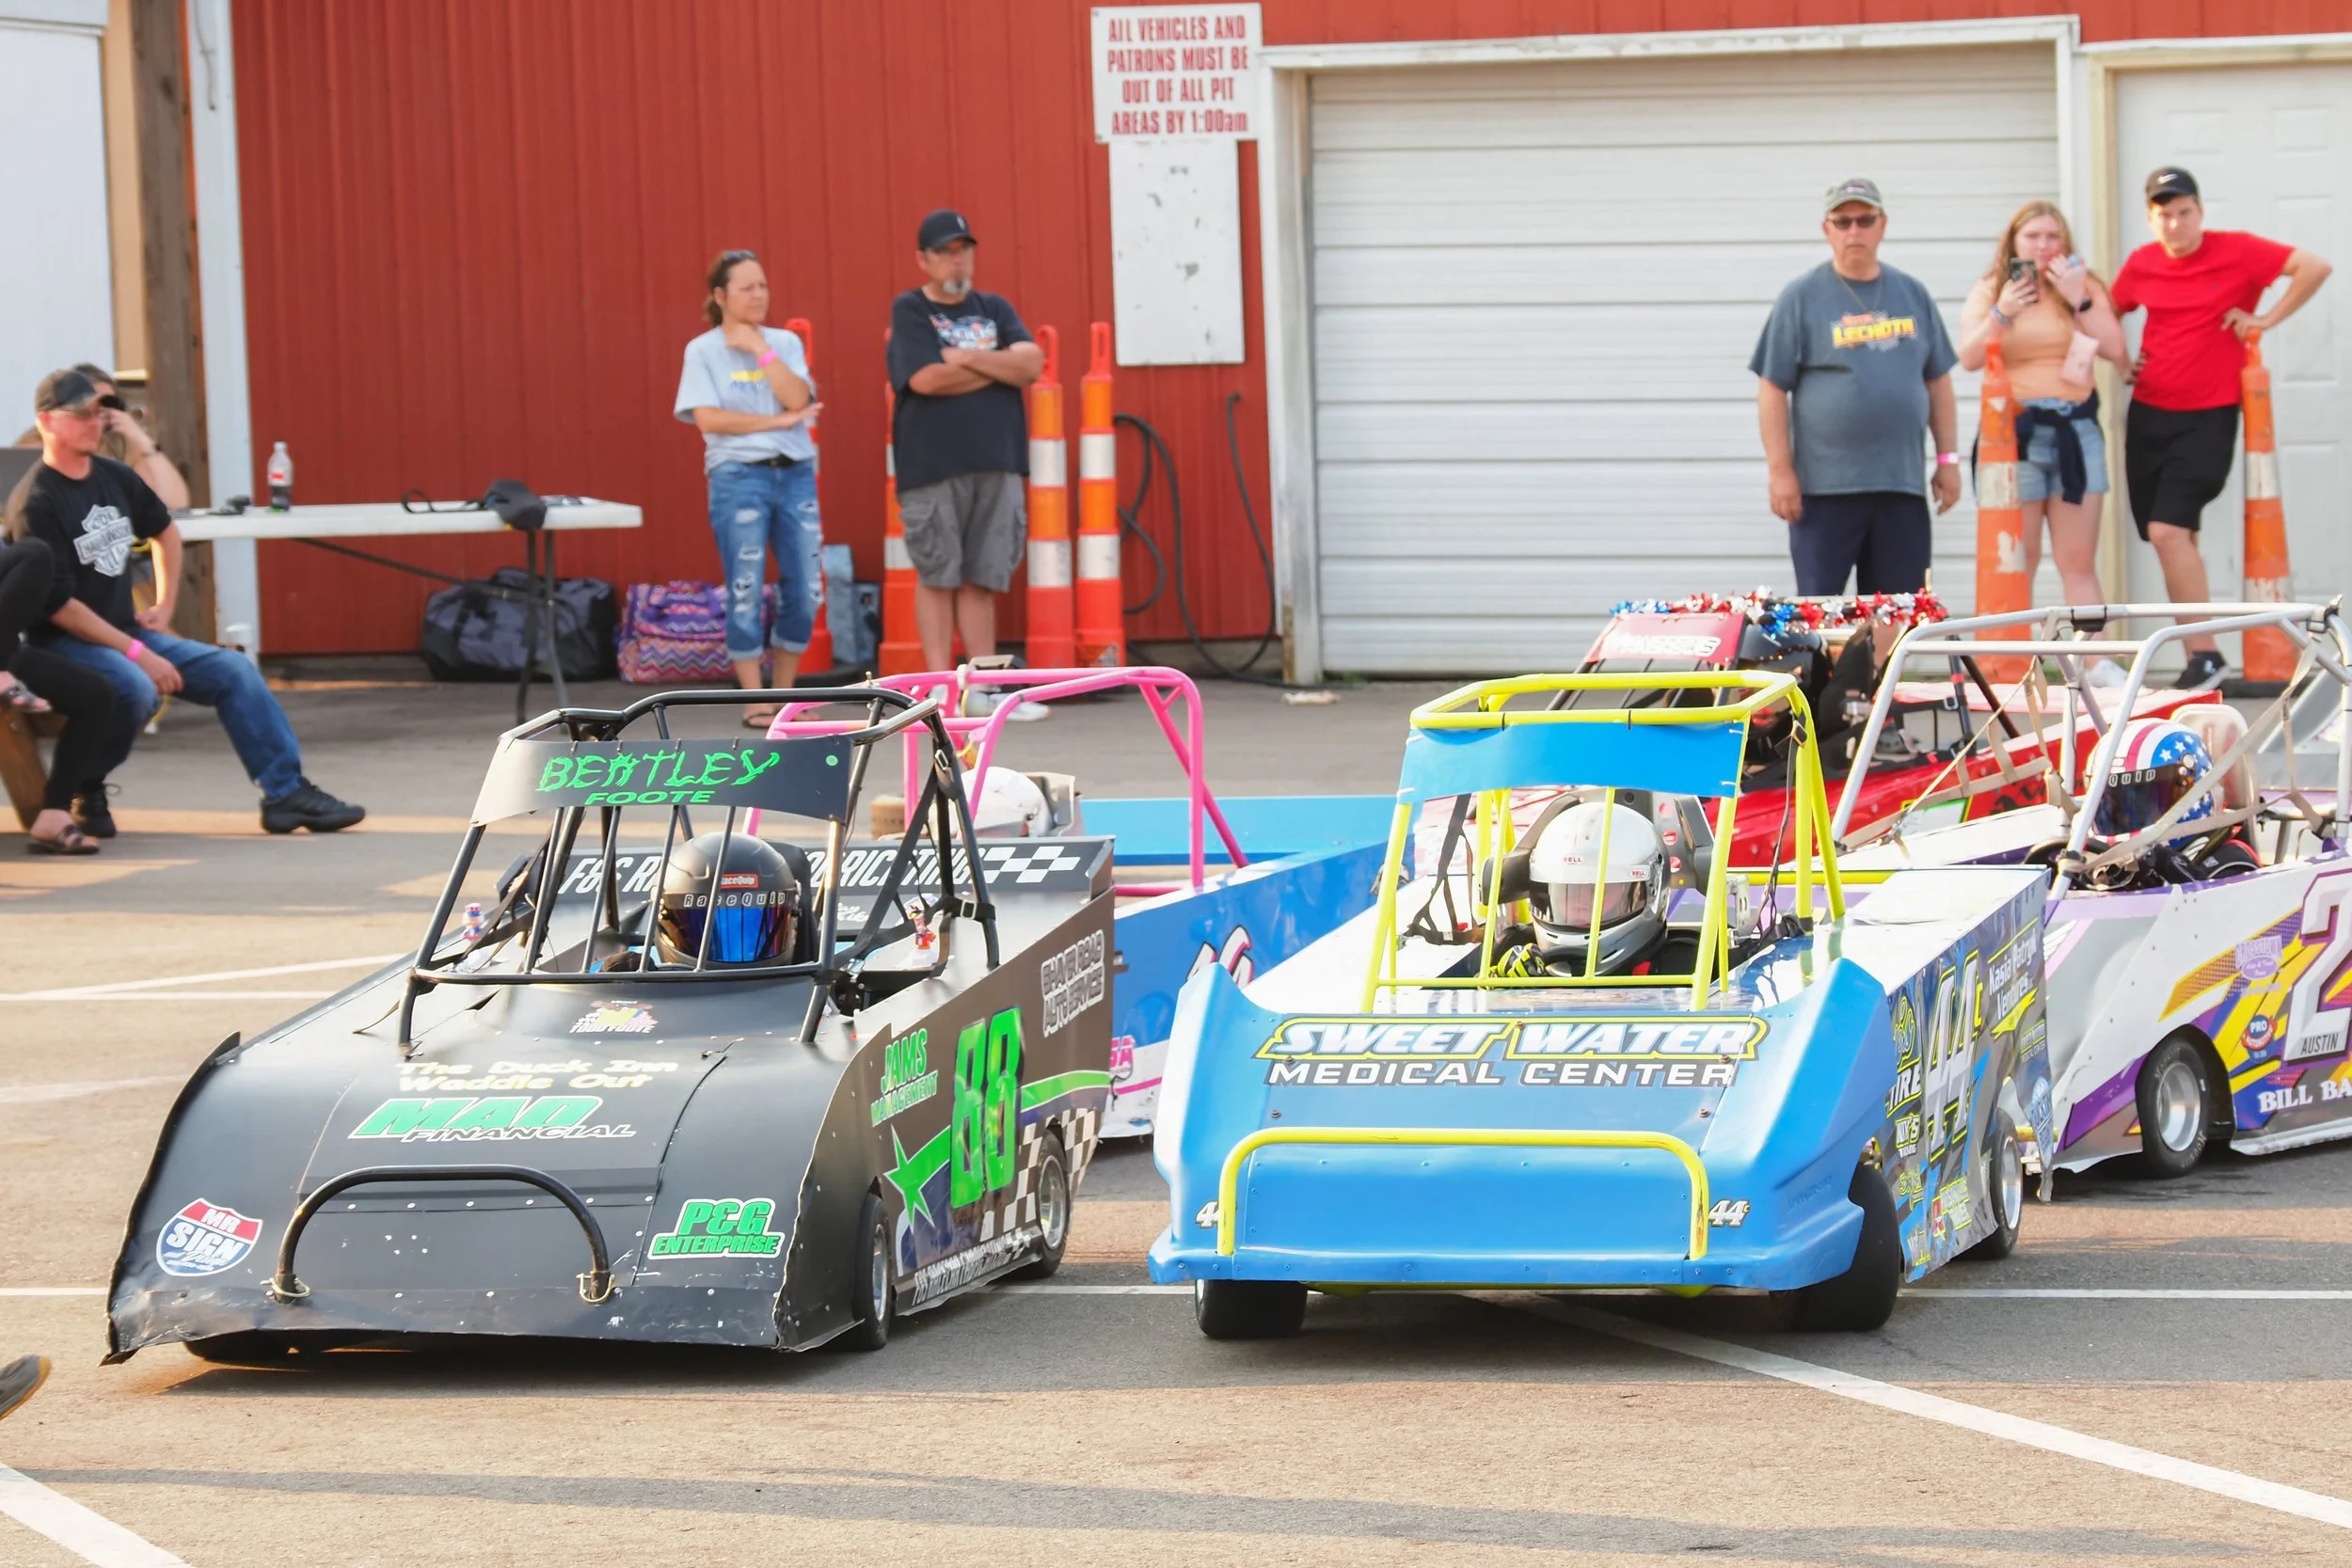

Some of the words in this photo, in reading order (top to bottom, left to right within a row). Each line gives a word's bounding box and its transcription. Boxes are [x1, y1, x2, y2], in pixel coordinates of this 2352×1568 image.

[1108, 18, 1132, 42] ALL
[1138, 16, 1208, 42] VEHICLES
[1215, 15, 1247, 40] AND
[1107, 47, 1175, 73] PATRONS
[1182, 45, 1224, 71] MUST
[1231, 45, 1249, 71] BE
[1122, 79, 1151, 103] OUT
[1156, 78, 1175, 103] OF
[1181, 77, 1205, 103] ALL
[1211, 76, 1235, 102] PIT
[1112, 110, 1159, 135] AREAS
[1167, 109, 1185, 135] BY
[1192, 109, 1248, 134] 1:00am
[535, 749, 780, 792] BENTLEY
[583, 790, 715, 806] FOOTE
[721, 876, 755, 886] aceQuip
[1271, 1022, 1500, 1055] SWEET
[1518, 1022, 1756, 1056] WATER
[2249, 1020, 2267, 1034] PRO
[2300, 1031, 2340, 1055] AUSTIN
[396, 1062, 473, 1076] The
[491, 1060, 593, 1075] Duck
[602, 1059, 678, 1073] Inn
[881, 1027, 929, 1096] JAMS
[1268, 1061, 1502, 1085] MEDICAL
[1522, 1061, 1735, 1086] CENTER
[396, 1075, 553, 1092] Waddle
[567, 1073, 655, 1089] Out
[870, 1069, 939, 1128] MANAGEMENT
[950, 1006, 1026, 1210] 88
[2257, 1085, 2313, 1114] BILL
[348, 1096, 603, 1139] MAD
[401, 1124, 636, 1143] FINANCIAL
[200, 1207, 242, 1234] MR
[675, 1200, 772, 1236] P&G
[1195, 1200, 1221, 1228] 4
[165, 1221, 245, 1263] SIGN
[651, 1235, 781, 1256] ENTERPRISE
